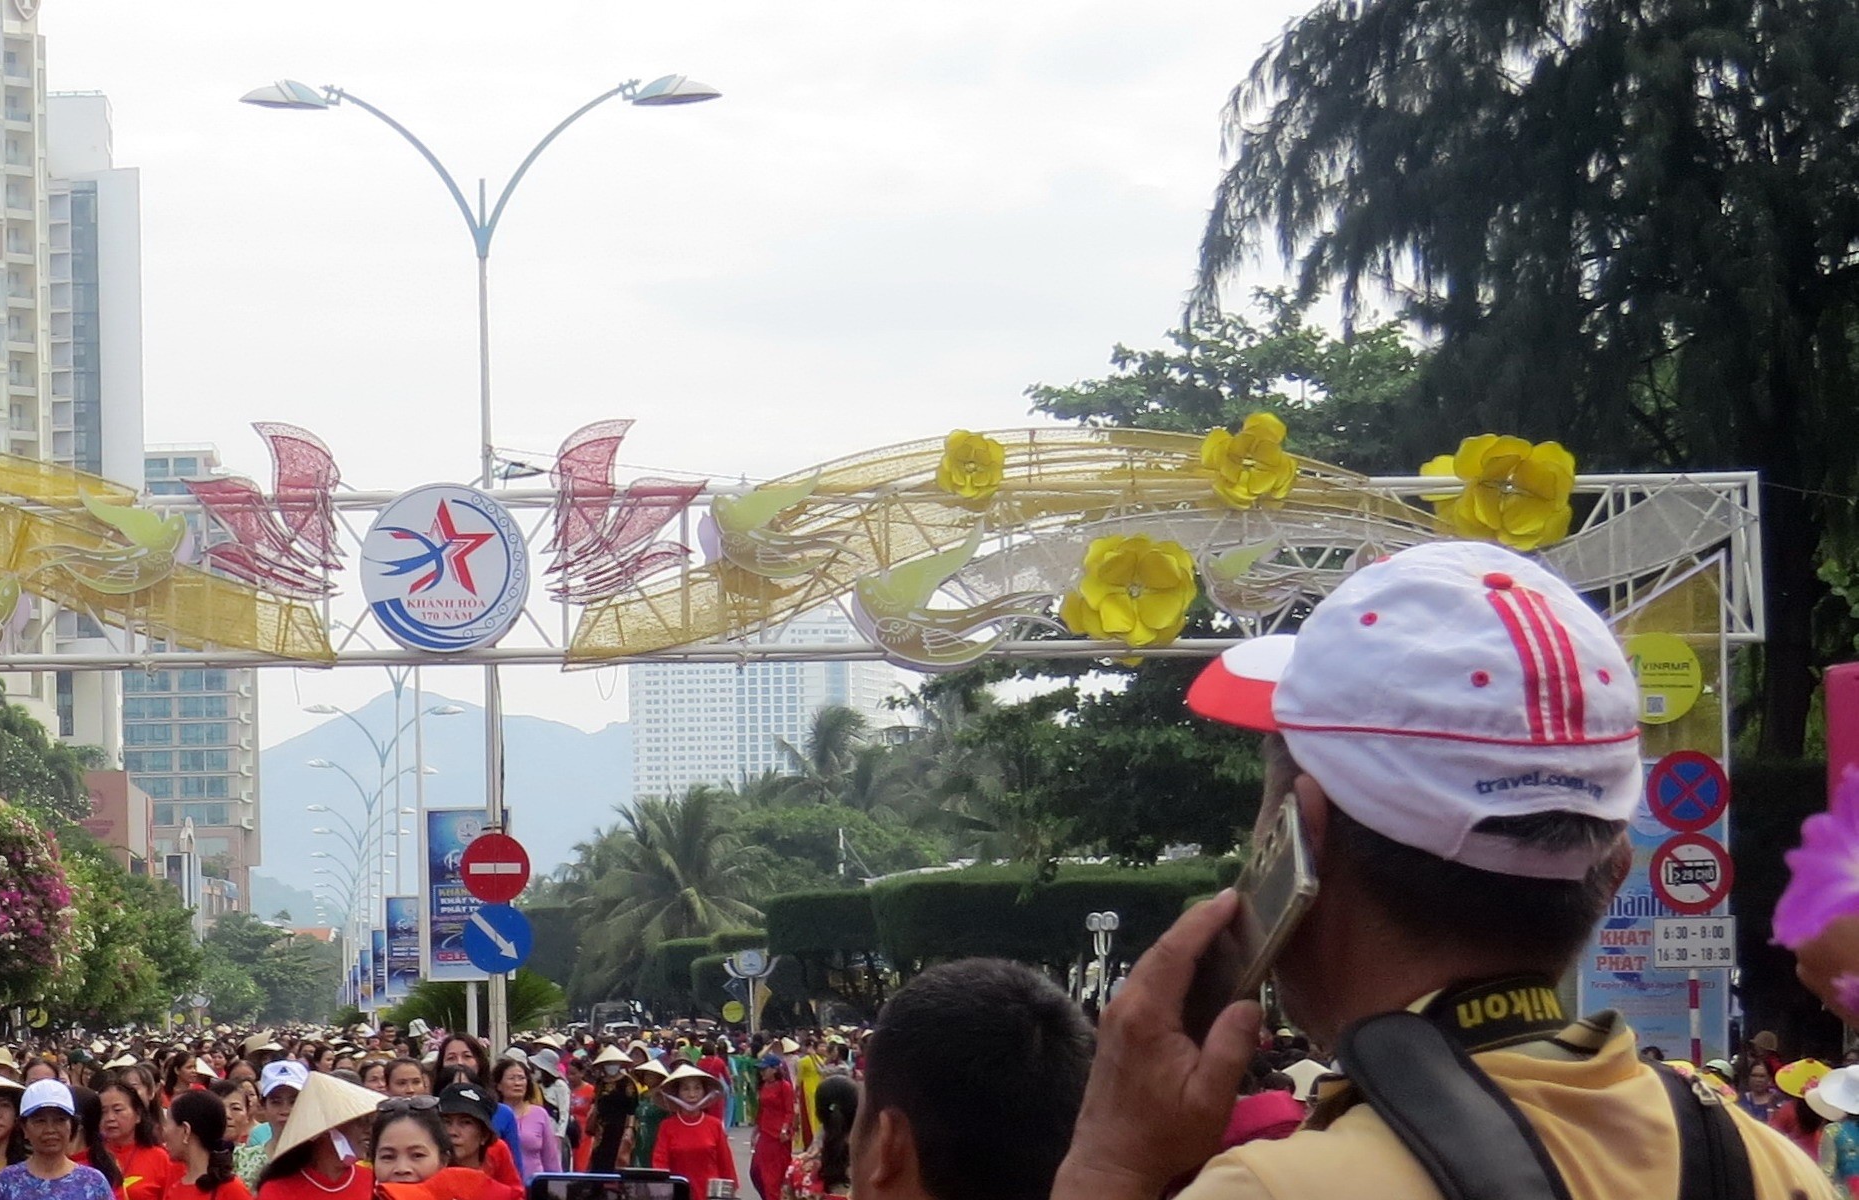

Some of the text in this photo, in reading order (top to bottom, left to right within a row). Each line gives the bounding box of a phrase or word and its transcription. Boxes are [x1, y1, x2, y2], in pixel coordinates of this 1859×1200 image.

[407, 597, 486, 608] KHÁNH HÒA
[422, 610, 473, 620] 370 NĂM
[1642, 662, 1690, 670] VINAMA
[1663, 926, 1688, 939] 6:30
[1700, 926, 1725, 939] 8:00
[1657, 948, 1688, 961] 16:30
[1701, 947, 1731, 961] 18:30
[1456, 987, 1563, 1029] Nikon
